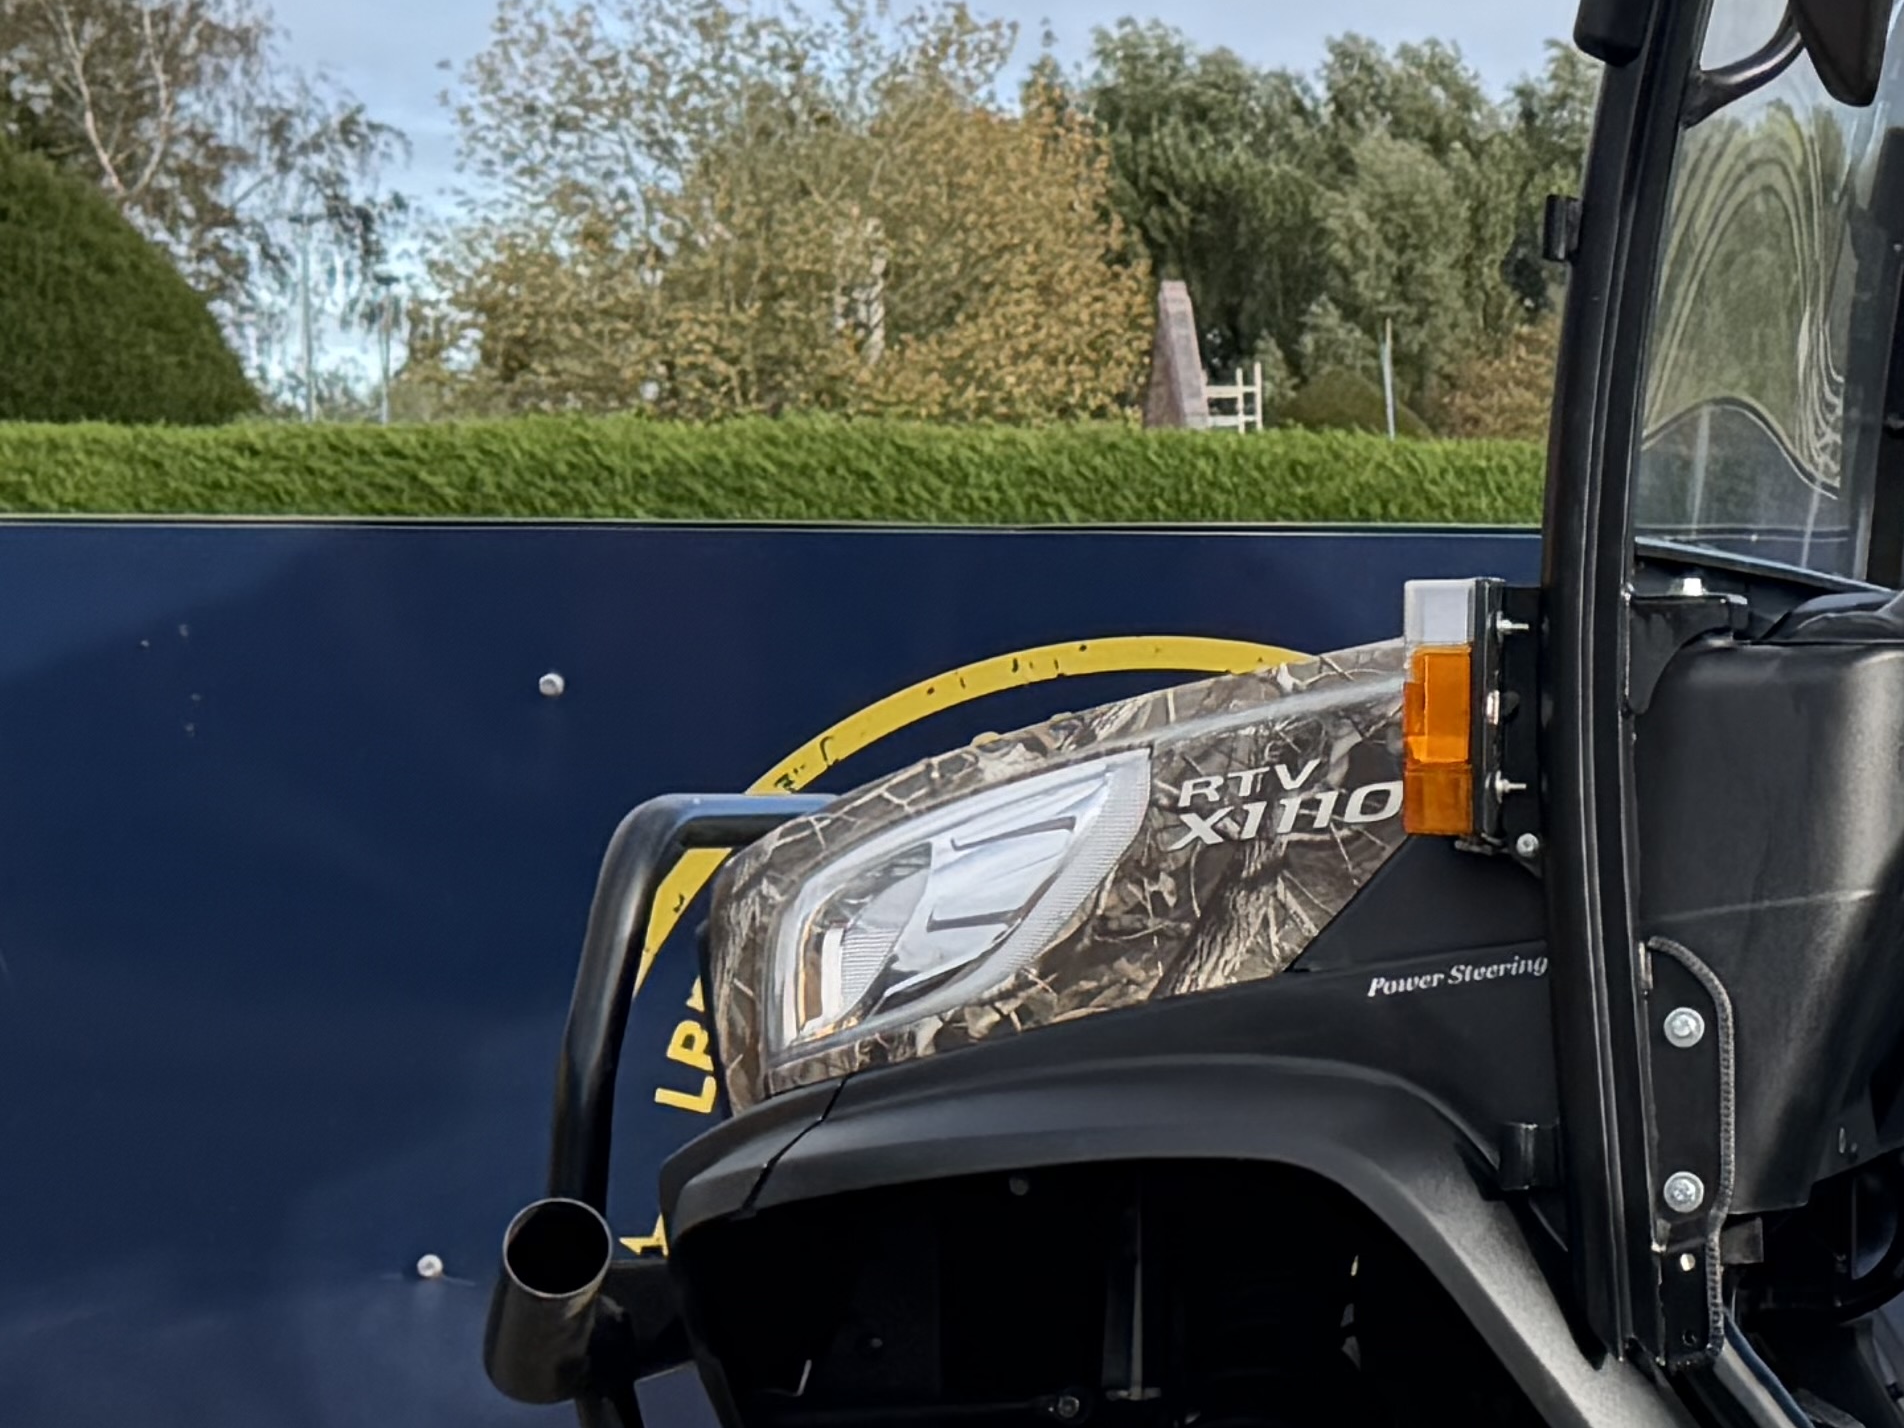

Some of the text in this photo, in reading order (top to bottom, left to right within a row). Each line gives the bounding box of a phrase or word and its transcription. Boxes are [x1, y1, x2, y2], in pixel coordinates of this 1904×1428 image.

[1177, 758, 1321, 808] RTV
[1367, 954, 1549, 998] Power Steering
